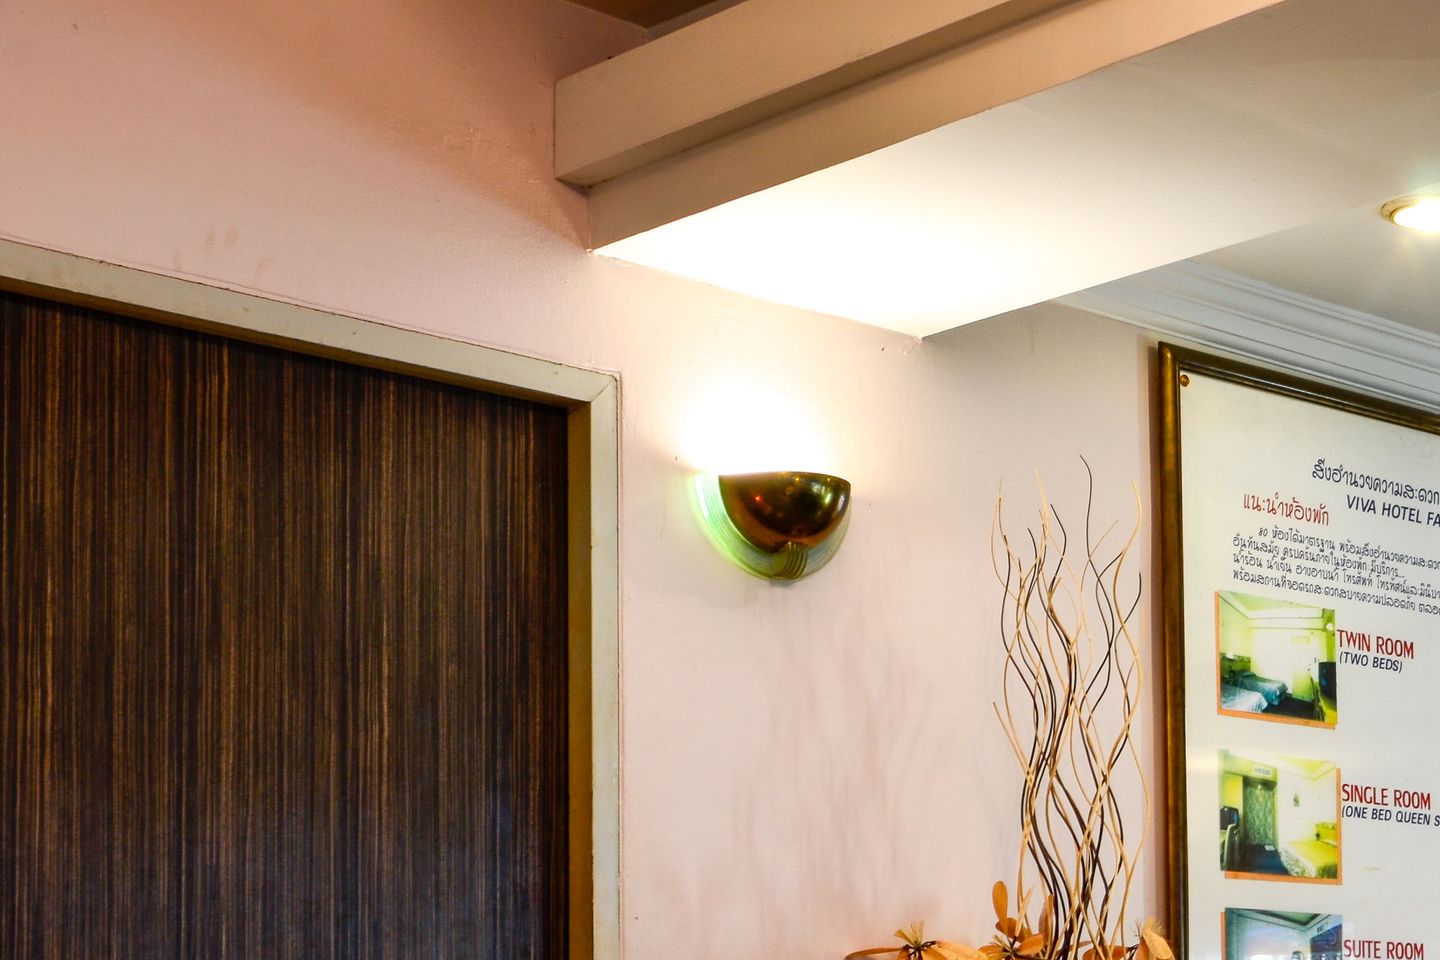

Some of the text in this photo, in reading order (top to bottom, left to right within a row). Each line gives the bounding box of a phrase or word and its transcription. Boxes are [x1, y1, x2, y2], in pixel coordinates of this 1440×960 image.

[1347, 494, 1376, 514] VIVA
[1381, 502, 1421, 524] HOTEL
[1337, 629, 1414, 659] TWIN ROOM
[1340, 651, 1402, 673] (TWO BEDS)
[1342, 783, 1431, 810] SINGLE ROOM
[1342, 805, 1368, 819] (ONE
[1371, 808, 1392, 821] BED
[1395, 810, 1431, 826] QUEEN
[1343, 939, 1424, 960] SUITE ROOM
